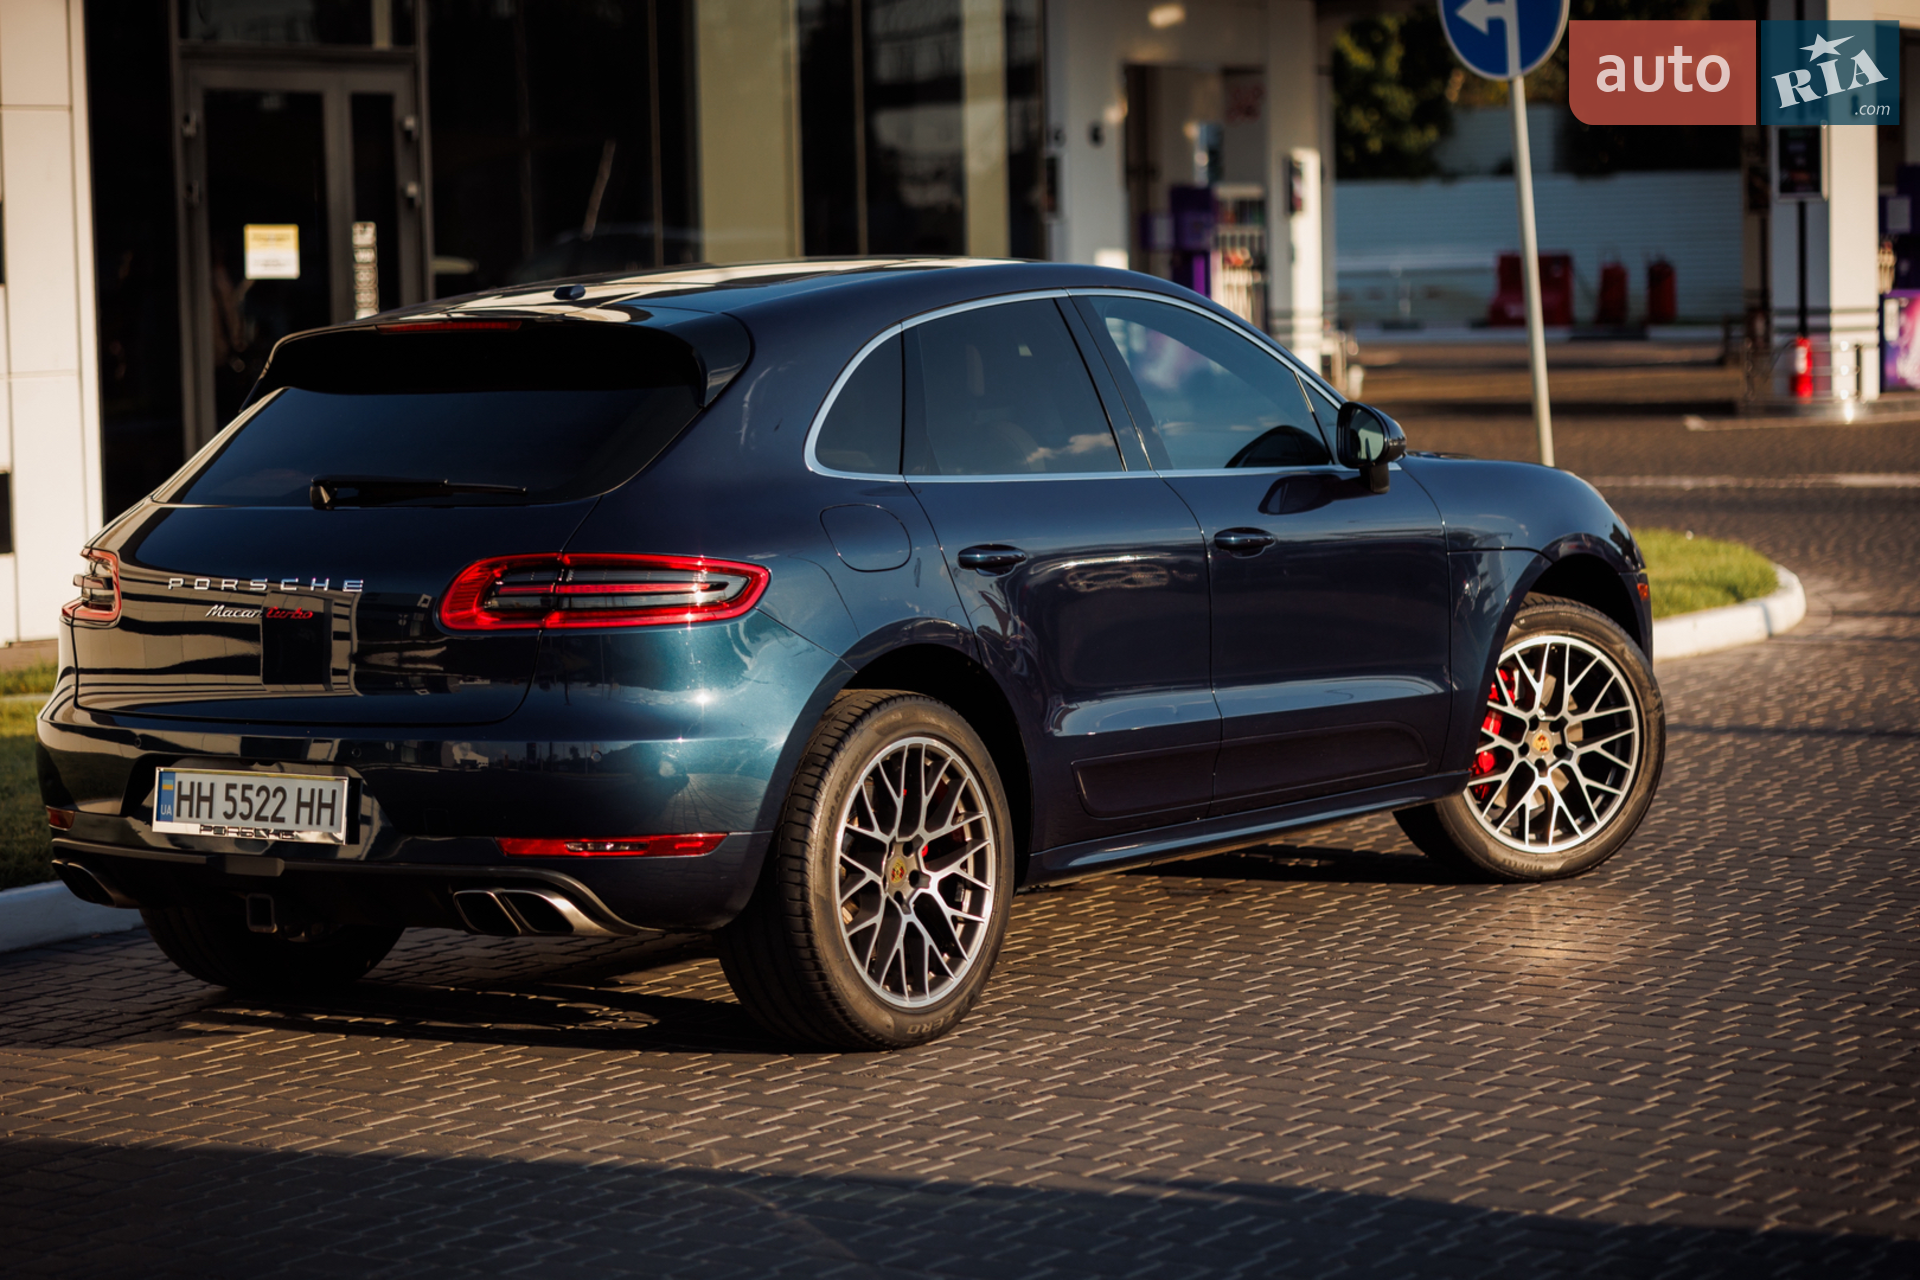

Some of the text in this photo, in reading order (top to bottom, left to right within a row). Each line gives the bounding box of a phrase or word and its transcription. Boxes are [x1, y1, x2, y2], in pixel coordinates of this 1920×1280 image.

[167, 577, 364, 593] PORSCHE
[205, 604, 263, 619] Macan
[160, 803, 173, 816] UA
[176, 780, 337, 827] HH 5522 HH
[199, 824, 296, 840] PORSCHE
